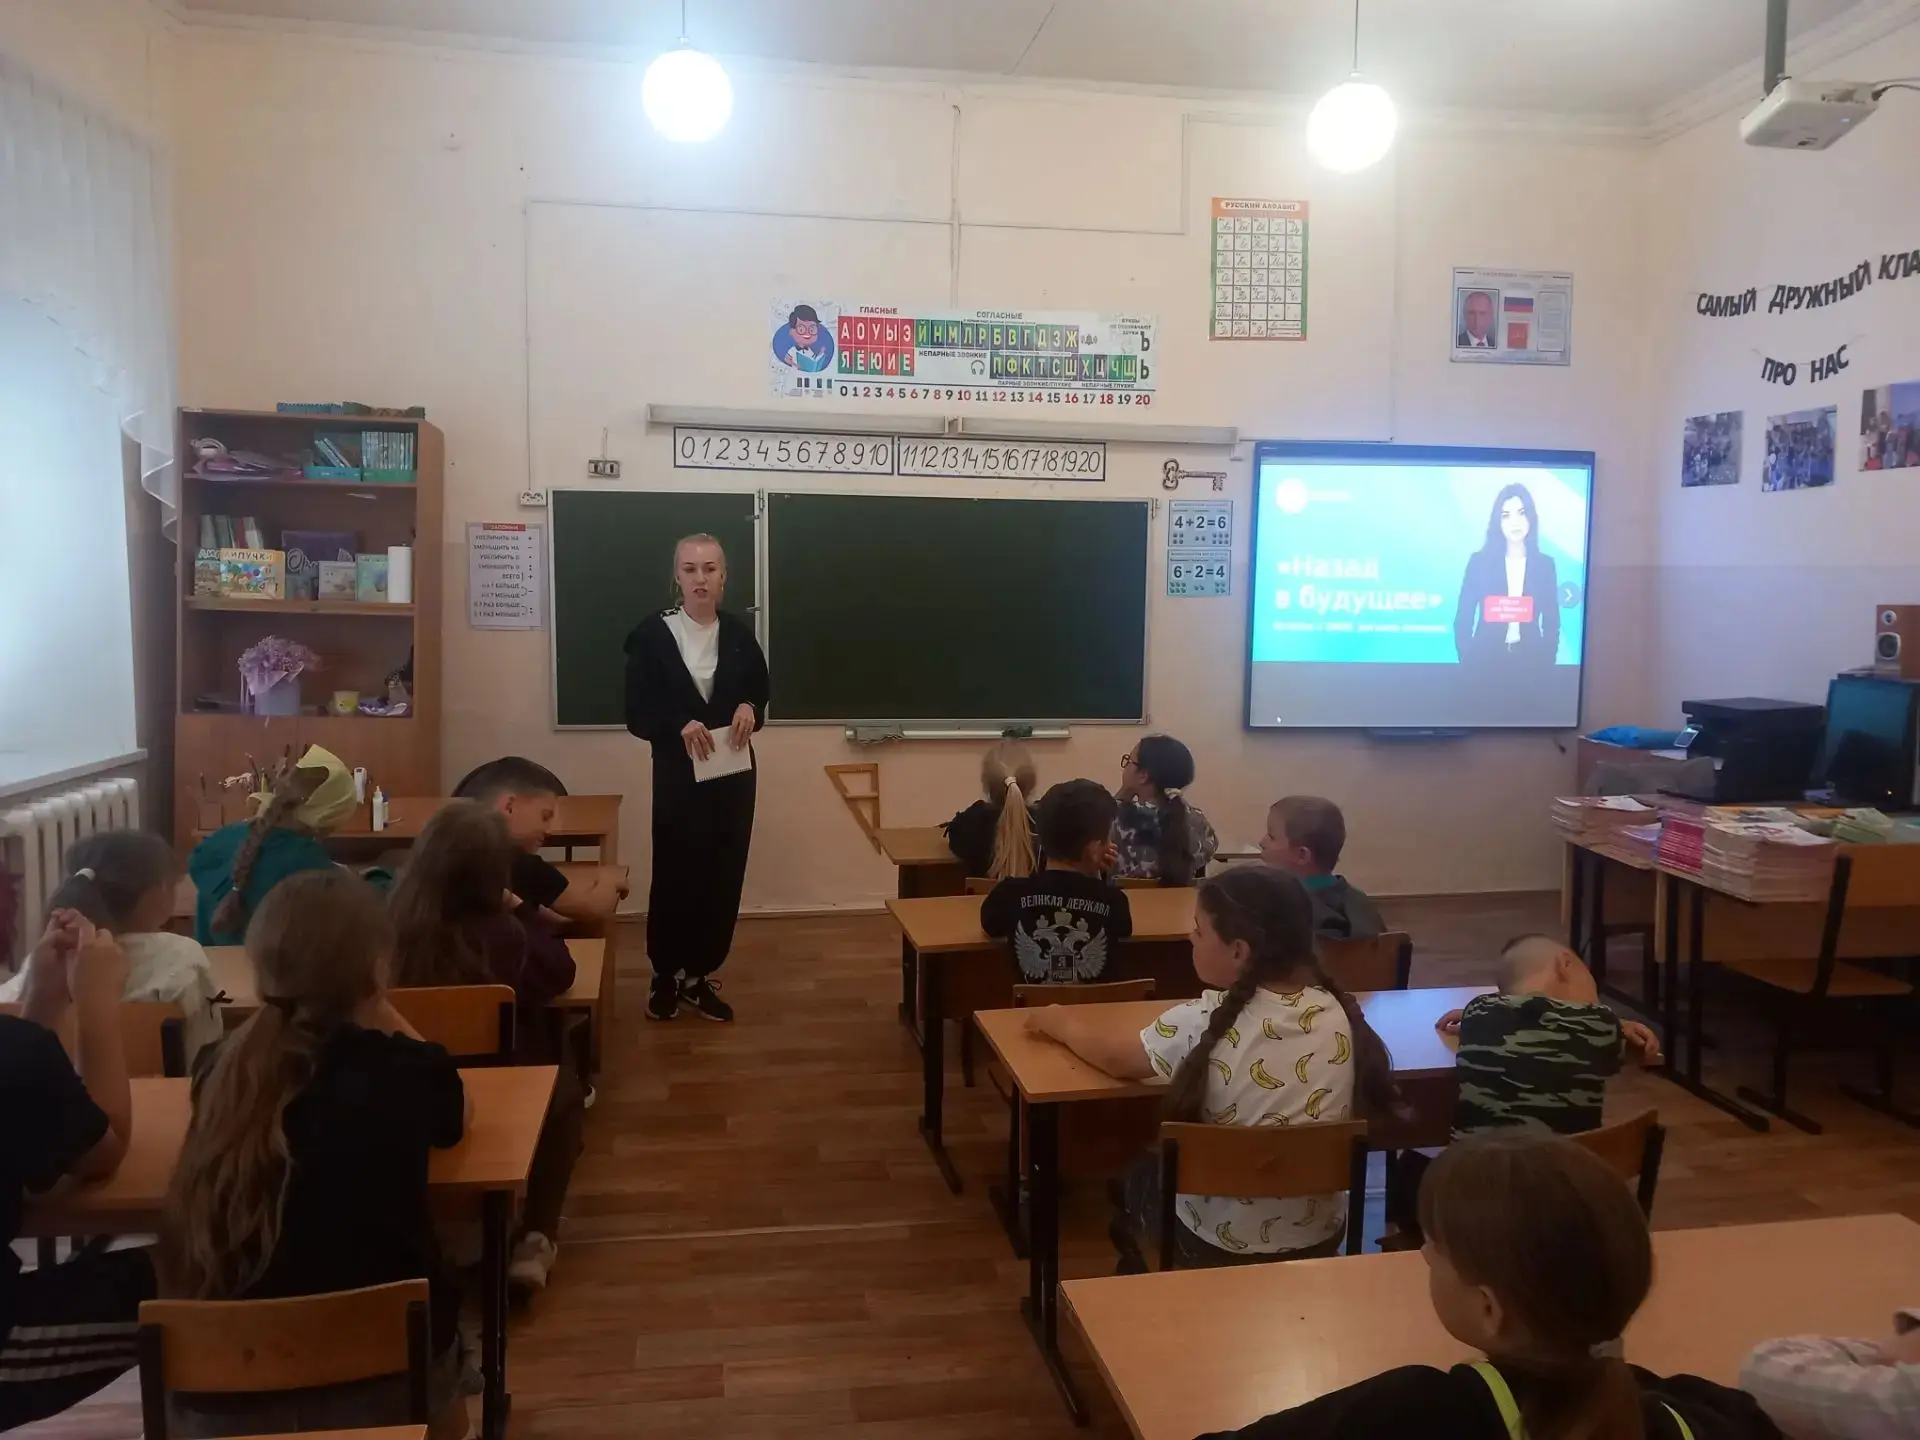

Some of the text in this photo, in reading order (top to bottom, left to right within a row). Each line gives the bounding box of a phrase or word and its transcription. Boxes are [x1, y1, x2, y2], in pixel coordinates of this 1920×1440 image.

[1696, 287, 1757, 317] САМЫЙ
[1768, 259, 1872, 314] ДРУЖНЫЙ
[859, 306, 898, 315] ГЛАСНЫЕ
[976, 310, 1023, 320] СОГЛАСНЫЕ
[918, 350, 956, 358] НЕПАРНЫЕ
[1761, 344, 1849, 386] ПРО НАС
[840, 386, 848, 396] 0
[852, 386, 859, 397] 1
[863, 387, 871, 397] 2
[874, 387, 882, 397] 3
[886, 388, 895, 398] 4
[899, 388, 906, 399] 5
[910, 388, 918, 399] 6
[923, 389, 930, 399] 7
[933, 389, 941, 400] 8
[945, 389, 953, 400] 9
[957, 390, 971, 401] 10
[975, 390, 988, 401] 11
[992, 392, 1006, 402] 12
[1010, 392, 1024, 402] 13
[1028, 392, 1043, 403] 14
[1047, 392, 1061, 403] 15
[1065, 393, 1079, 404] 16
[1083, 393, 1095, 404] 17
[1100, 394, 1113, 405] 18
[1117, 394, 1131, 405] 19
[1135, 395, 1151, 406] 20
[681, 436, 889, 466] 0 1 2 3 4 5 6 7 8 9 10
[1020, 893, 1111, 917] ВЕЛИКАЯ ДЕРЖАВА
